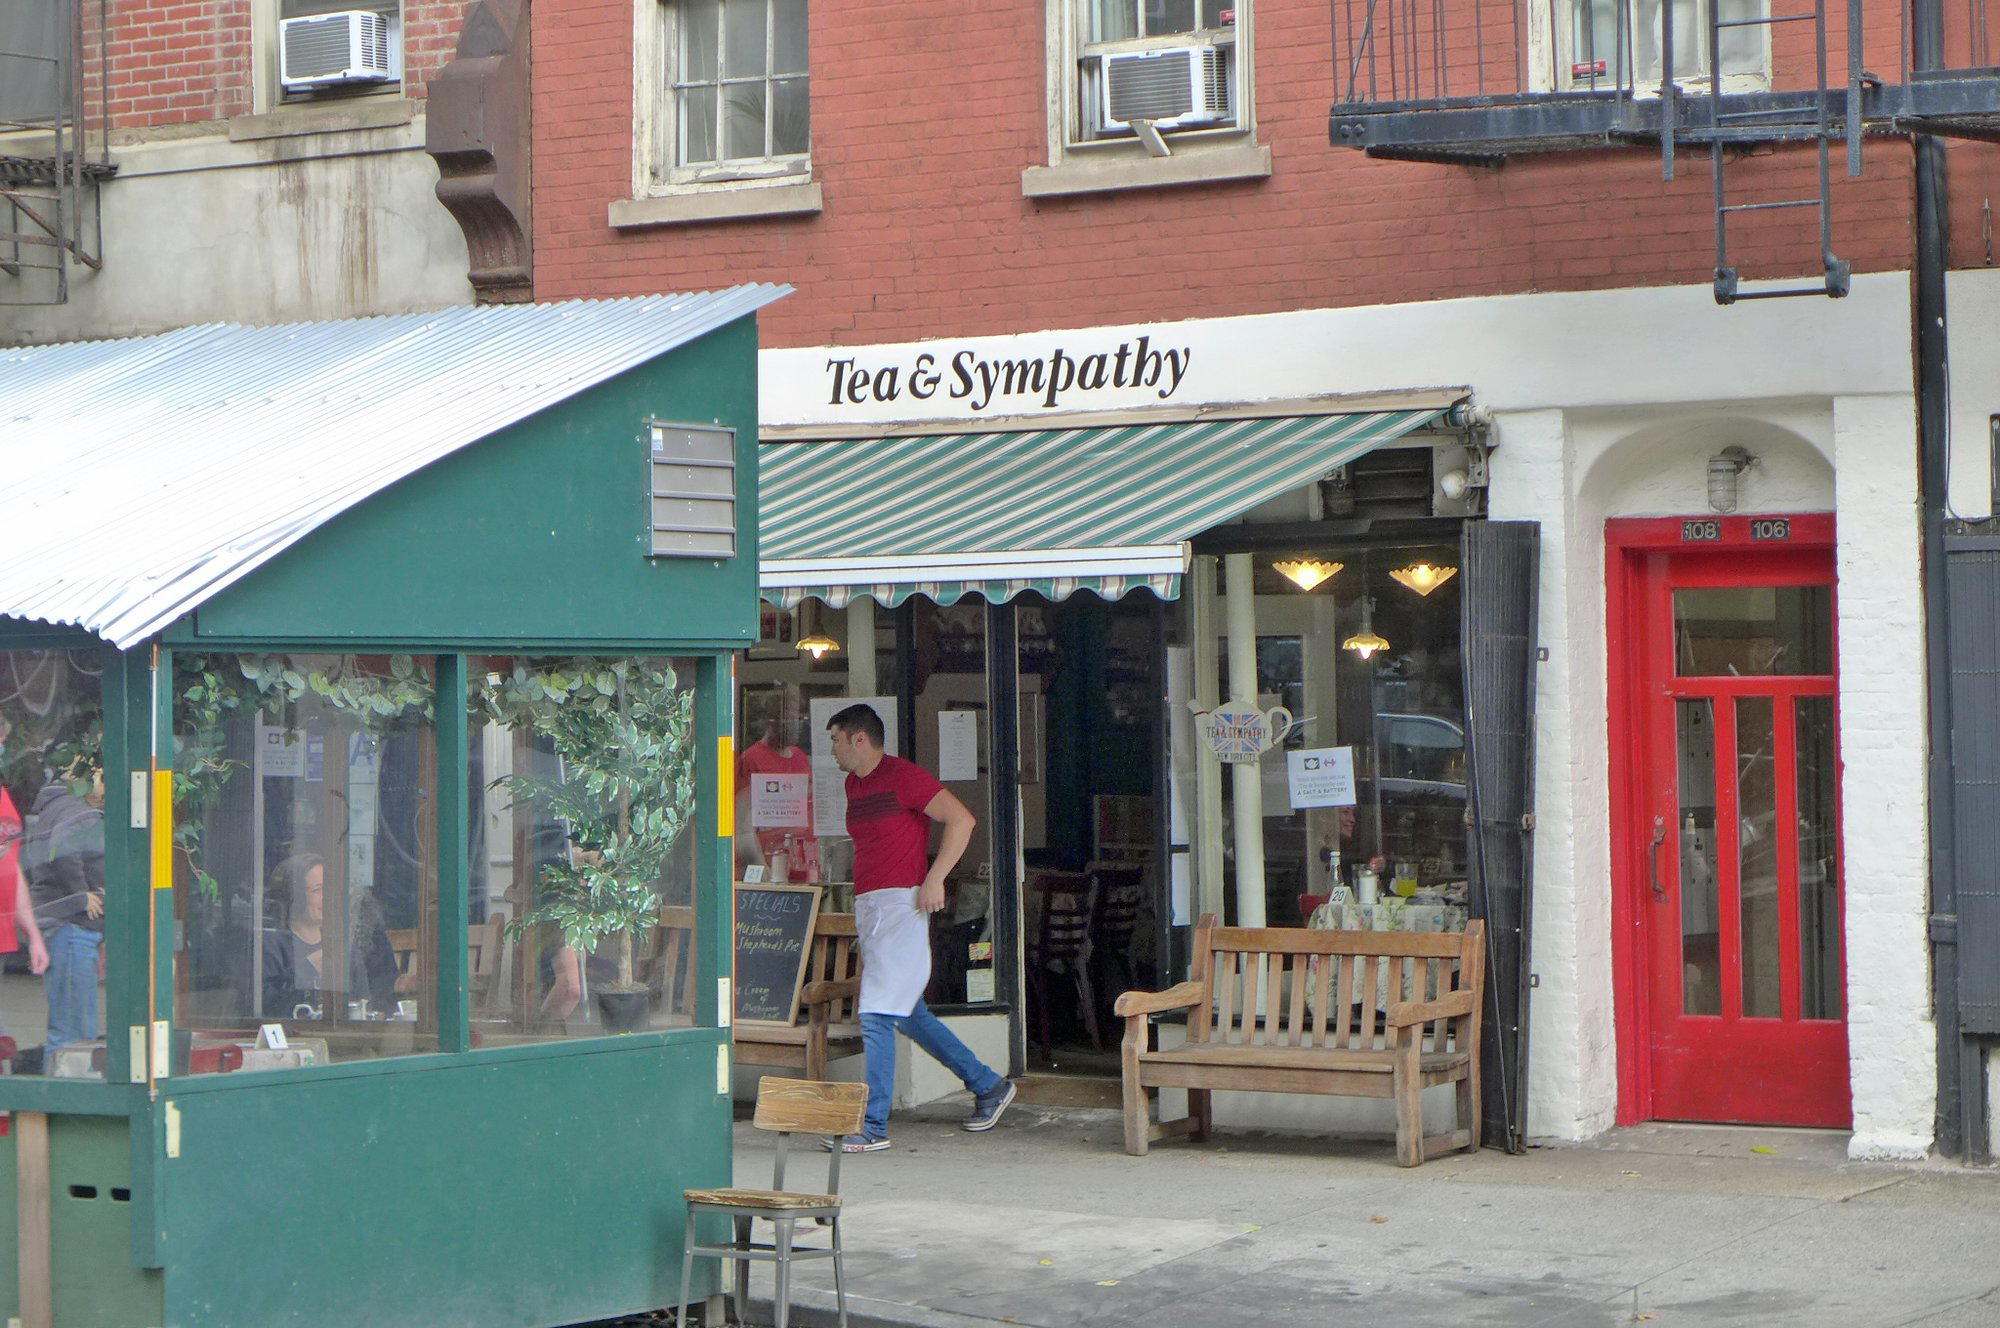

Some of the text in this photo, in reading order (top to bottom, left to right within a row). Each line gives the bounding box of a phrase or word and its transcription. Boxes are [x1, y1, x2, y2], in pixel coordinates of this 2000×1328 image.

[826, 335, 1191, 411] Tea & Sympathy
[1685, 522, 1717, 539] 108
[1754, 521, 1786, 538] 106
[1206, 726, 1219, 738] TEA
[739, 892, 801, 913] SPECIALS
[1332, 890, 1345, 902] 20
